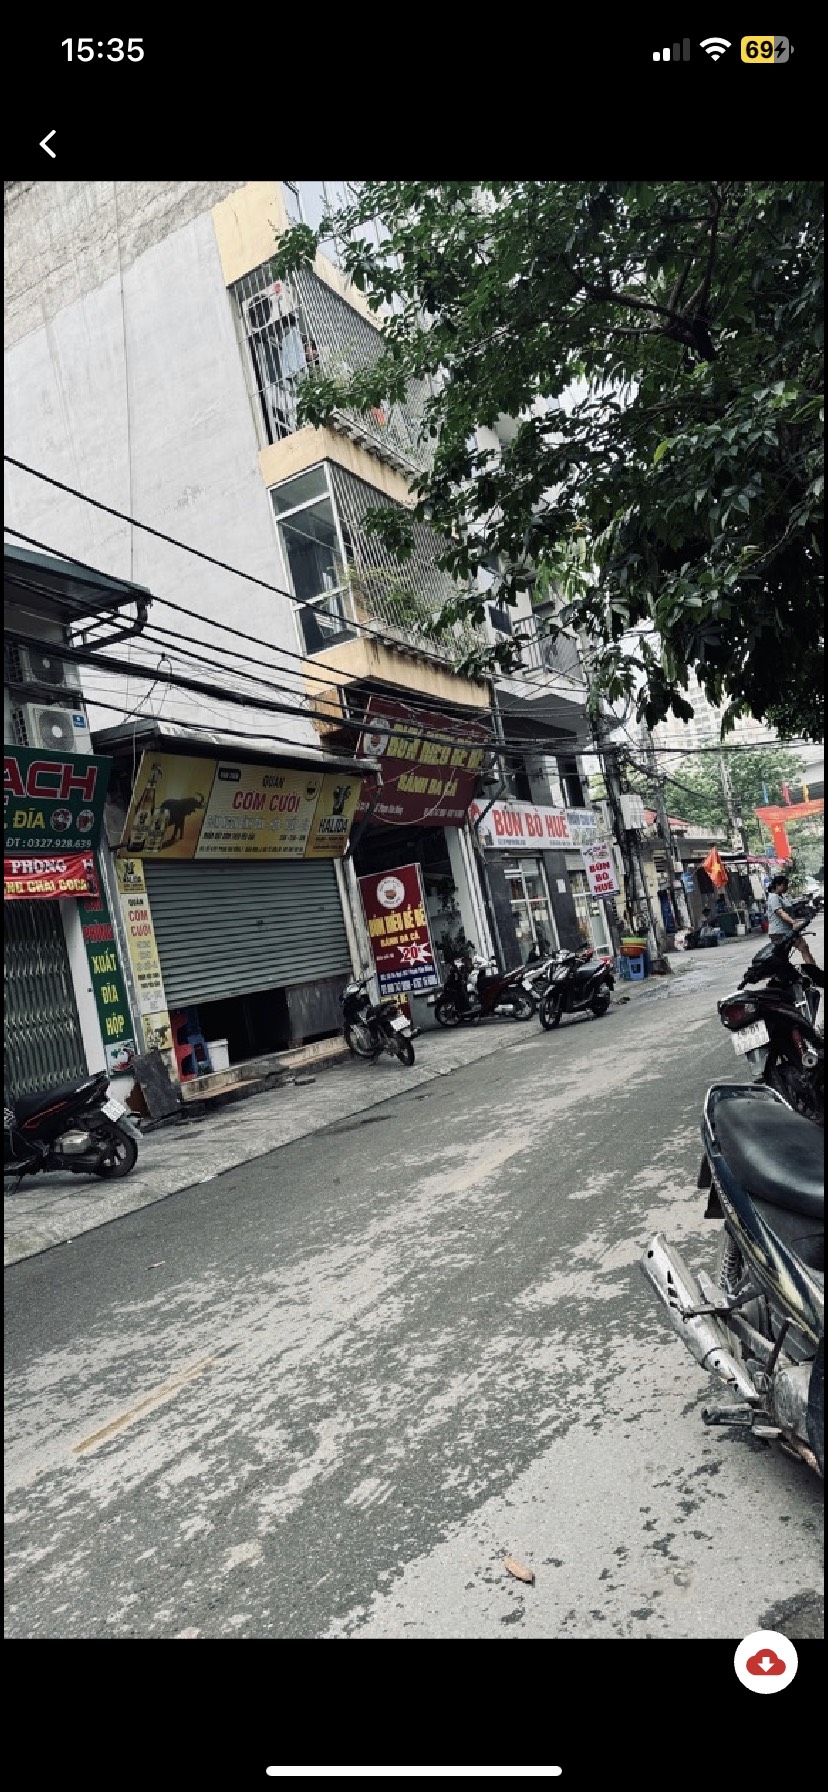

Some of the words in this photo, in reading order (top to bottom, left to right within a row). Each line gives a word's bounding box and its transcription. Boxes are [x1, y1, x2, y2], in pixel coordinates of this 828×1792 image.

[13, 808, 46, 829] ĐĨA
[492, 805, 524, 837] BÚN
[525, 808, 544, 838] BÒ
[545, 808, 570, 838] HUẾ
[101, 983, 119, 1004] ĐĨA
[106, 1012, 125, 1038] HỘP
